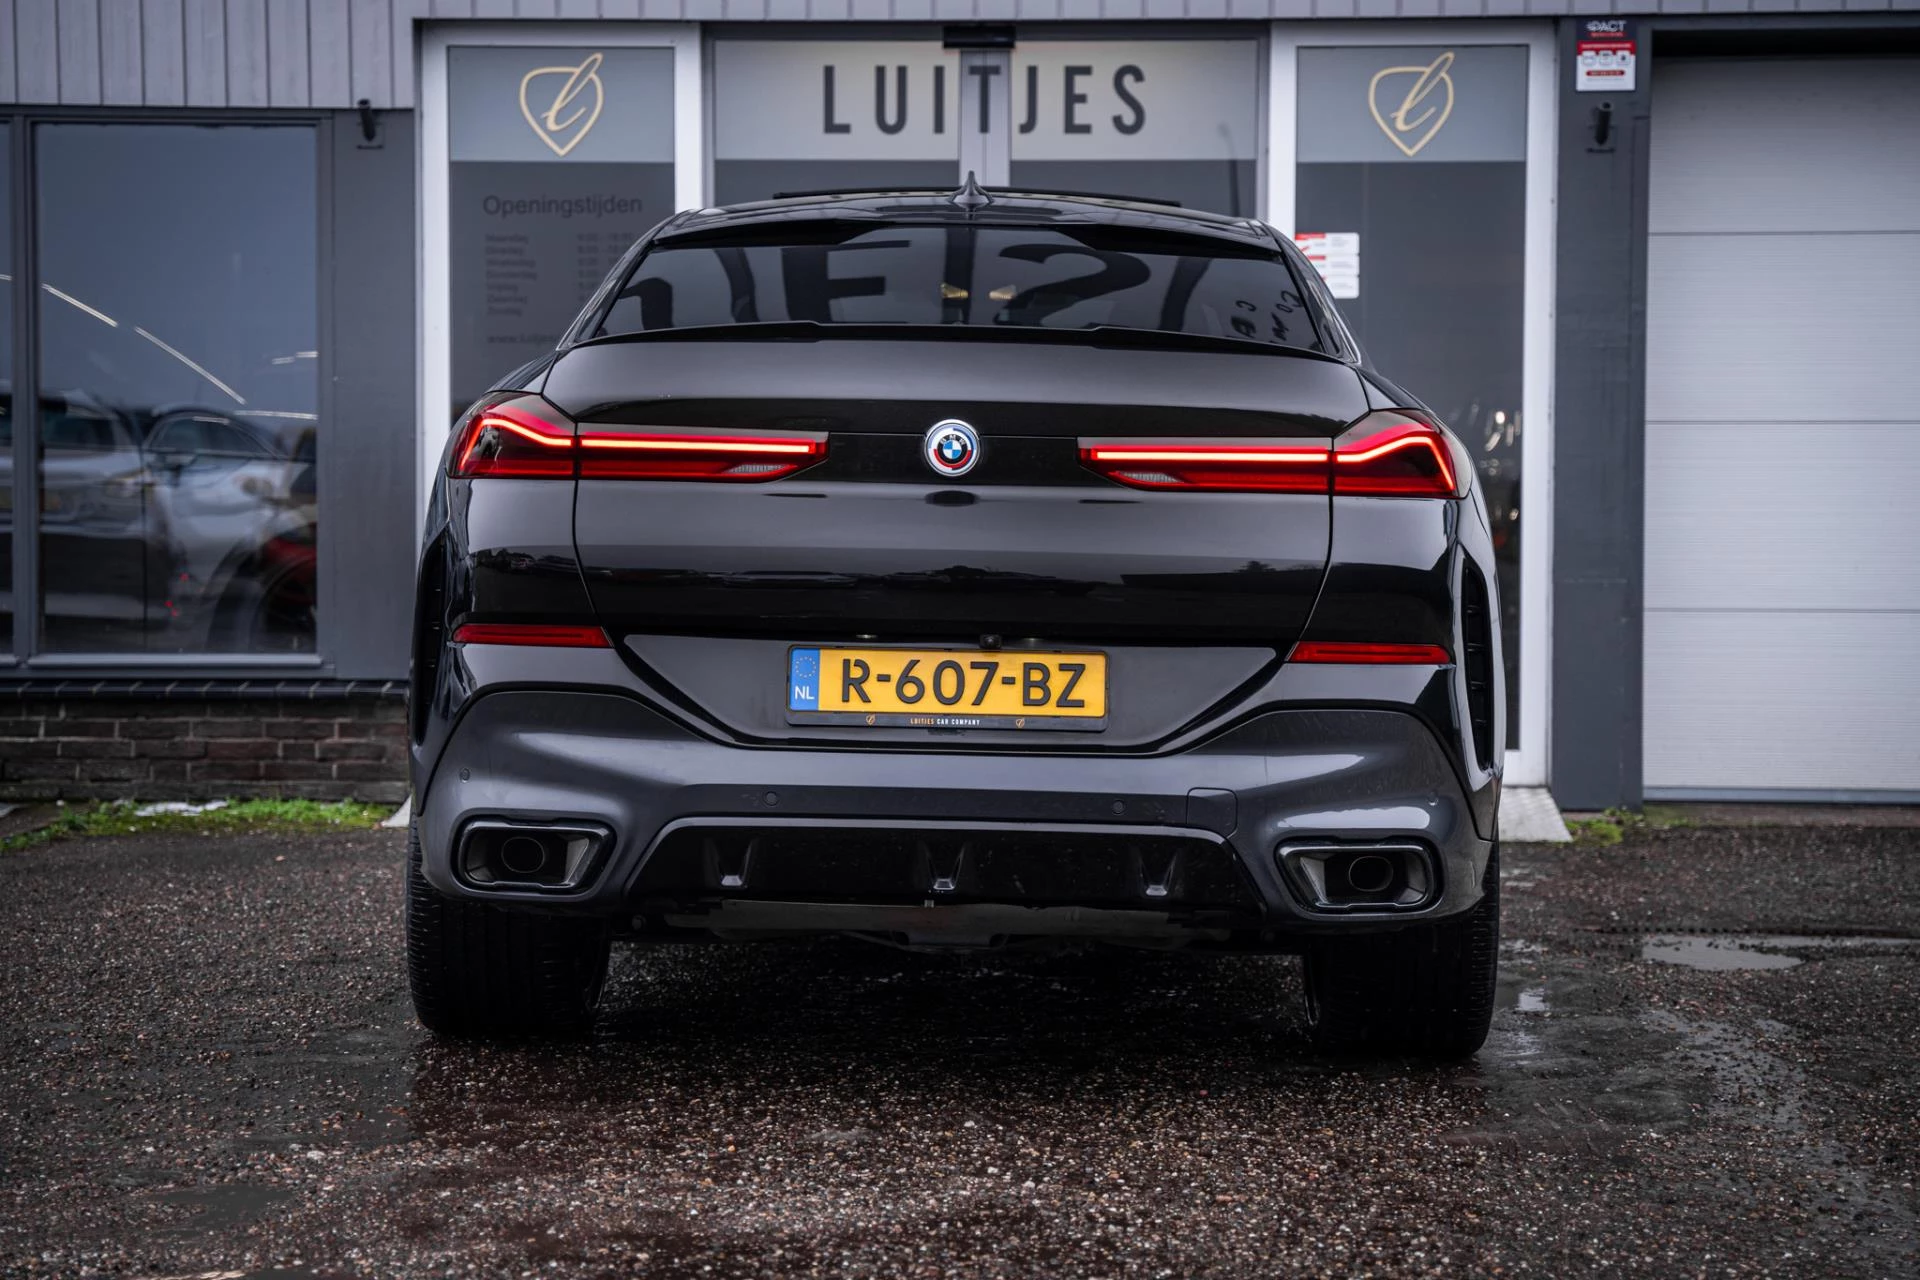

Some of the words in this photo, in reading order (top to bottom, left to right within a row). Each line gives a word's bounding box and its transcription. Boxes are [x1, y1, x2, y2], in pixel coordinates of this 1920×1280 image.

[823, 64, 1146, 135] LUITJES
[483, 194, 643, 218] Openingstijden
[940, 434, 966, 445] BMW
[794, 686, 815, 700] NL
[841, 658, 1087, 709] R-607-BZ
